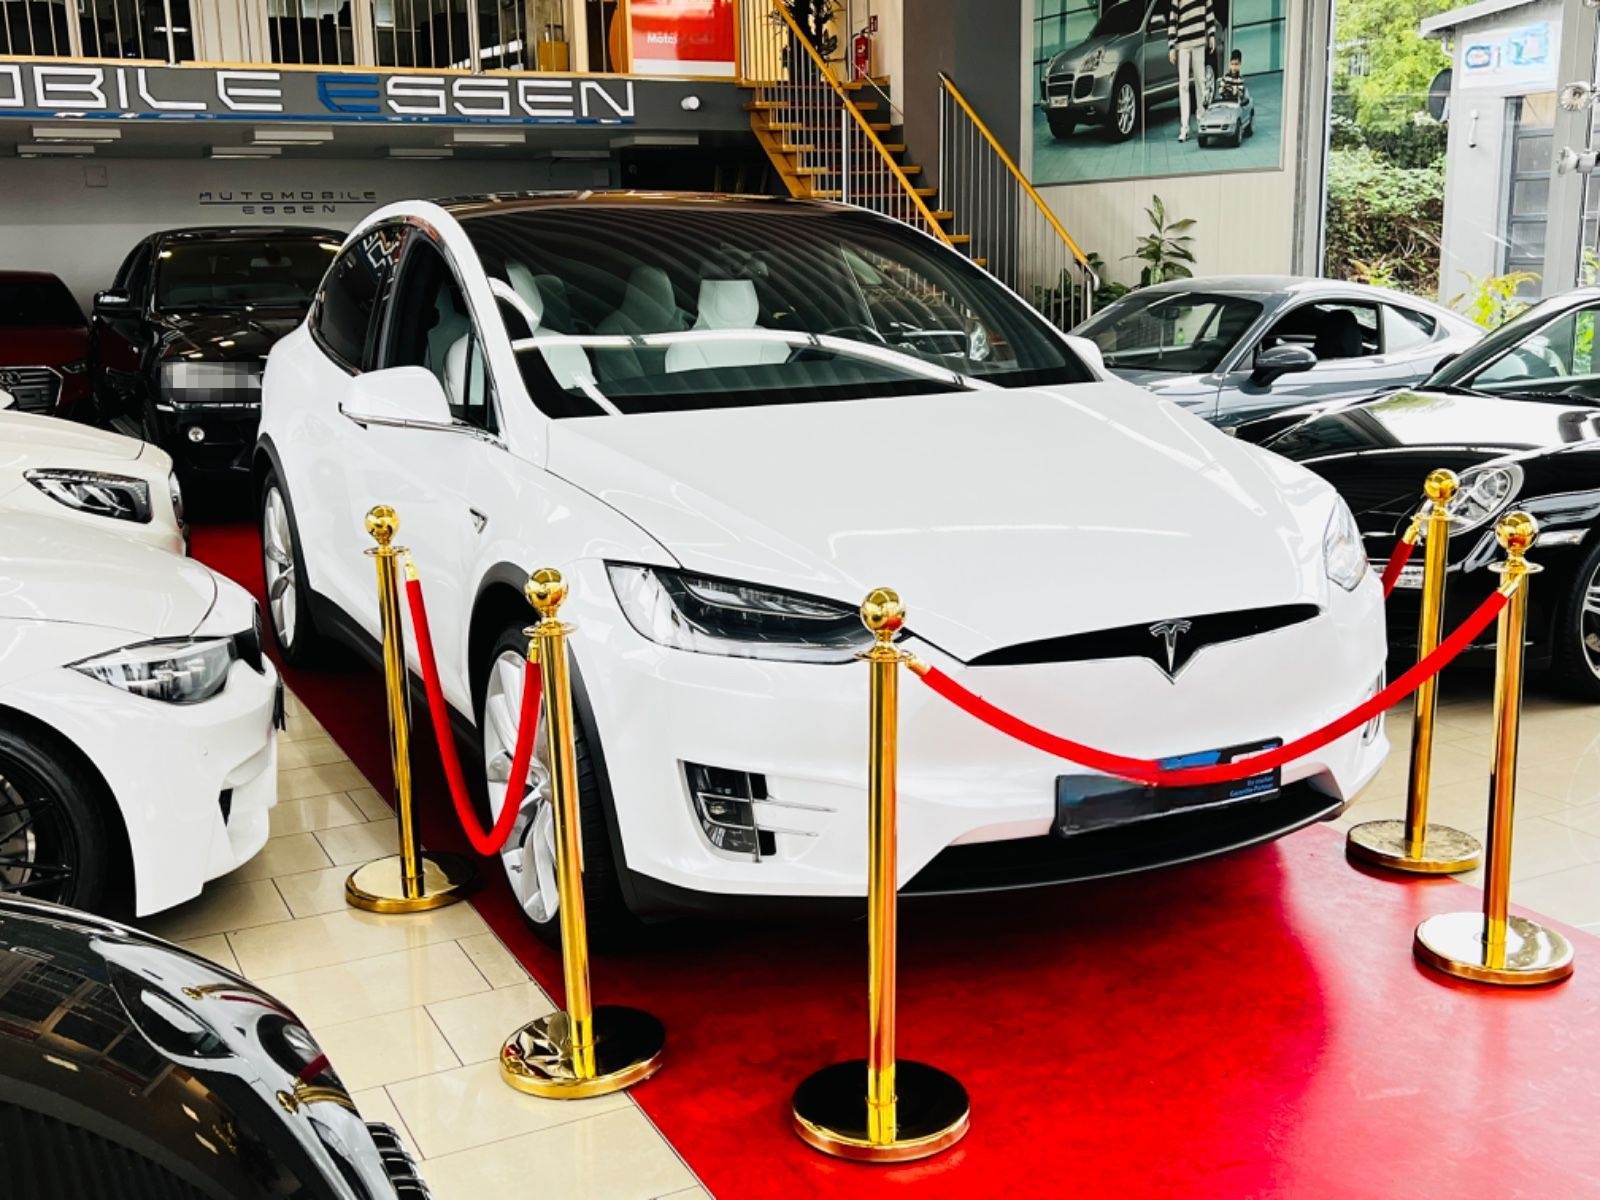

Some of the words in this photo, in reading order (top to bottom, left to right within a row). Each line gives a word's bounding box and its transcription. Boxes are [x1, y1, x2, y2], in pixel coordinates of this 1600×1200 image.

[316, 74, 635, 117] ESSEN
[199, 191, 376, 201] AUTOMOBILE
[242, 204, 336, 215] ESSEN
